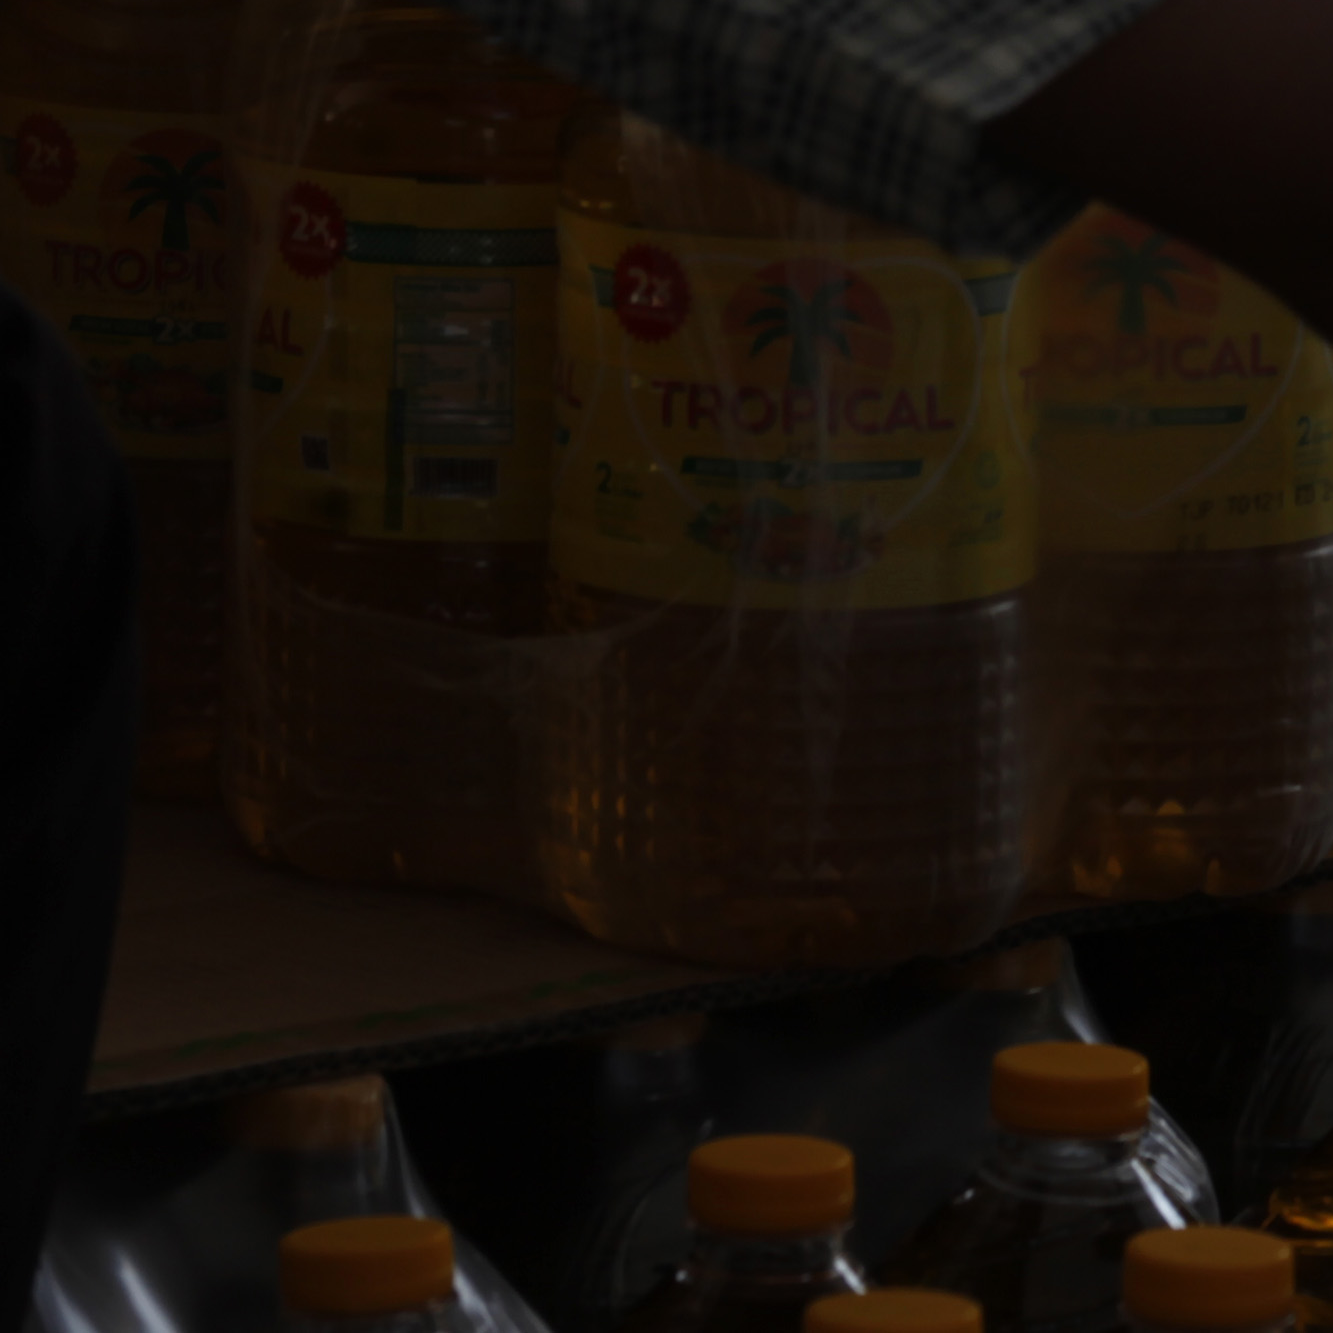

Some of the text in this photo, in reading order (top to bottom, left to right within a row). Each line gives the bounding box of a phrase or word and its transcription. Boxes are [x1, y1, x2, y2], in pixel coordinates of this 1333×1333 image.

[24, 135, 62, 172] 2x
[288, 206, 331, 242] 2x
[625, 267, 673, 307] 2x
[156, 317, 196, 344] 2x
[651, 378, 955, 436] TROPICAL
